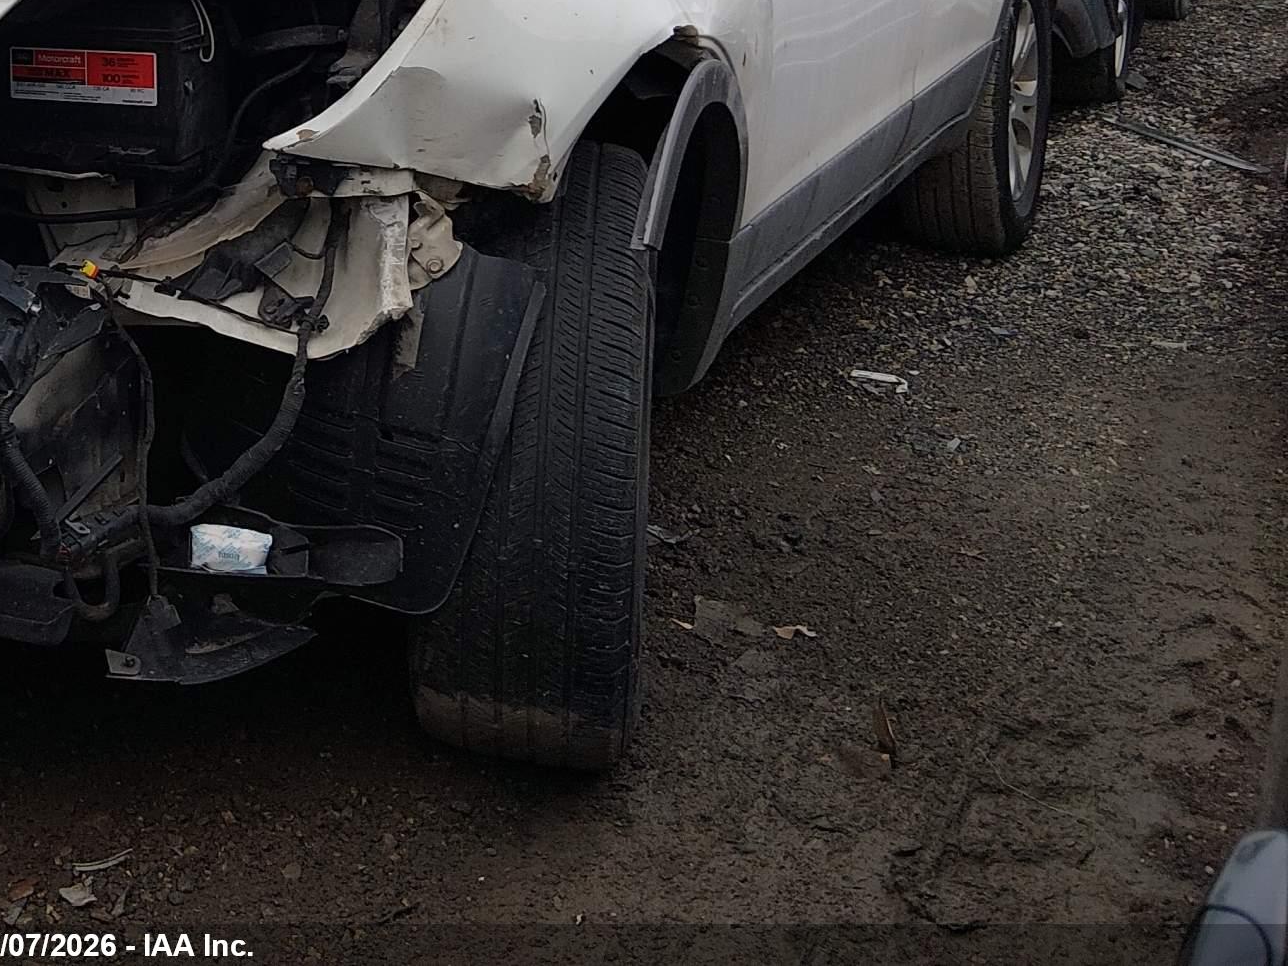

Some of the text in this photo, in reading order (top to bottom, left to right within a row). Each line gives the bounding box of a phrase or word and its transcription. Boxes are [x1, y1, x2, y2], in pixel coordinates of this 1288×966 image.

[37, 54, 82, 64] Motorcraft
[102, 57, 116, 67] 36
[101, 73, 121, 84] 100
